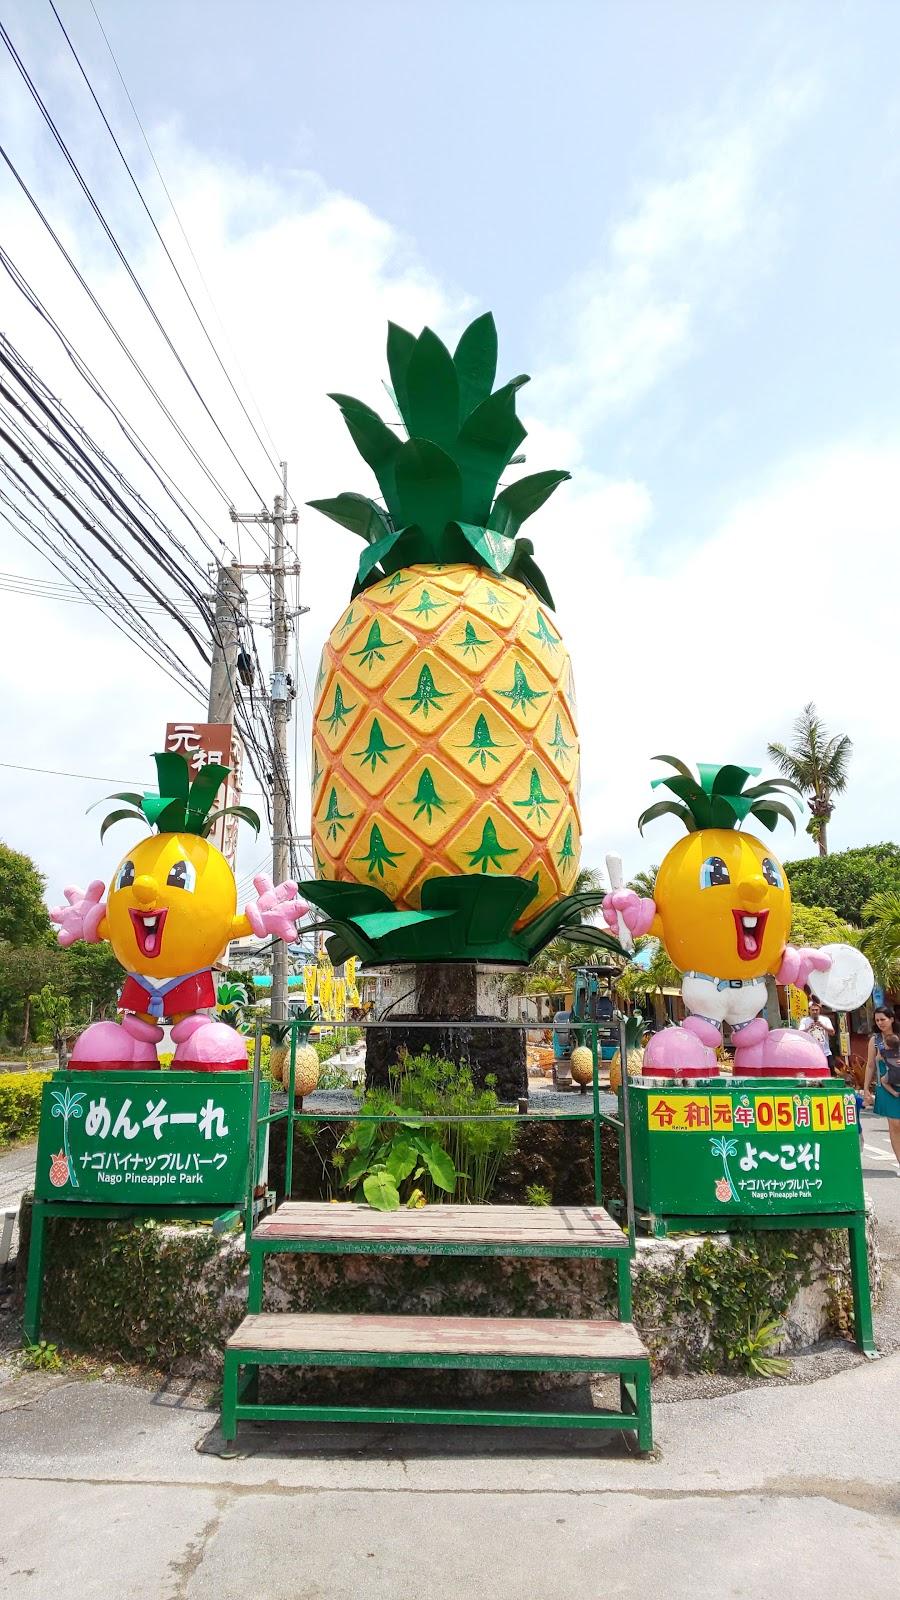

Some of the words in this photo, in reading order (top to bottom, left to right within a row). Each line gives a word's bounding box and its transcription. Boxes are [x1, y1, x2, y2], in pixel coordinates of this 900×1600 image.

[85, 1097, 229, 1140] めんそーれ
[79, 1151, 228, 1171] ナゴパイナップルパーク
[97, 1171, 123, 1185] Nago
[125, 1172, 177, 1186] Pineapple
[179, 1172, 204, 1184] Park
[751, 1190, 768, 1199] Nago
[769, 1190, 798, 1199] Pineapple
[799, 1190, 812, 1198] Park
